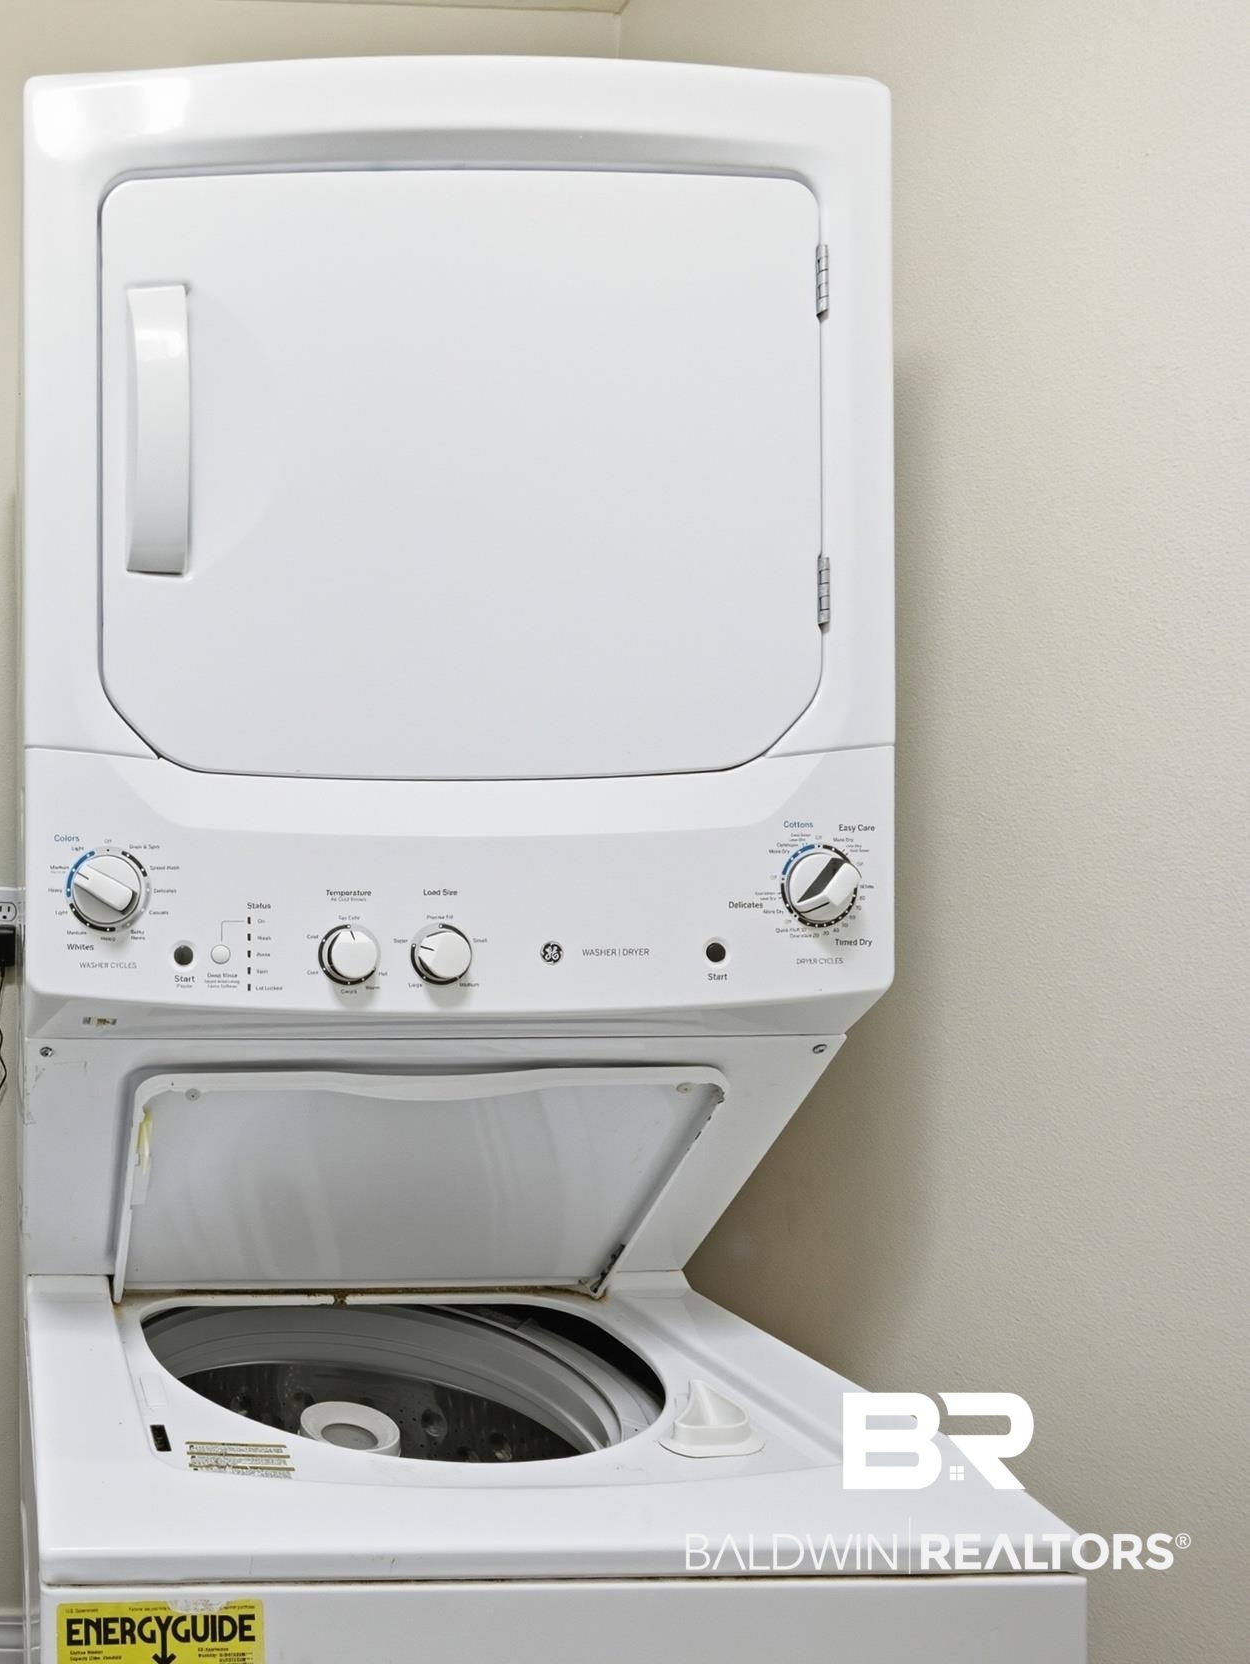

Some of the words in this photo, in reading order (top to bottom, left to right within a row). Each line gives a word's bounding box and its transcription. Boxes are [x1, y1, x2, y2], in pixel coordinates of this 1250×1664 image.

[838, 824, 856, 832] Easy
[54, 834, 80, 842] Colors
[326, 889, 372, 897] Temperature
[247, 902, 271, 910] Status
[728, 901, 763, 909] Delicates
[859, 939, 872, 947] Dry
[582, 948, 617, 958] WASHER
[622, 948, 650, 957] DRYER
[708, 973, 728, 981] Start
[66, 1614, 256, 1647] ENERGYGUIDE
